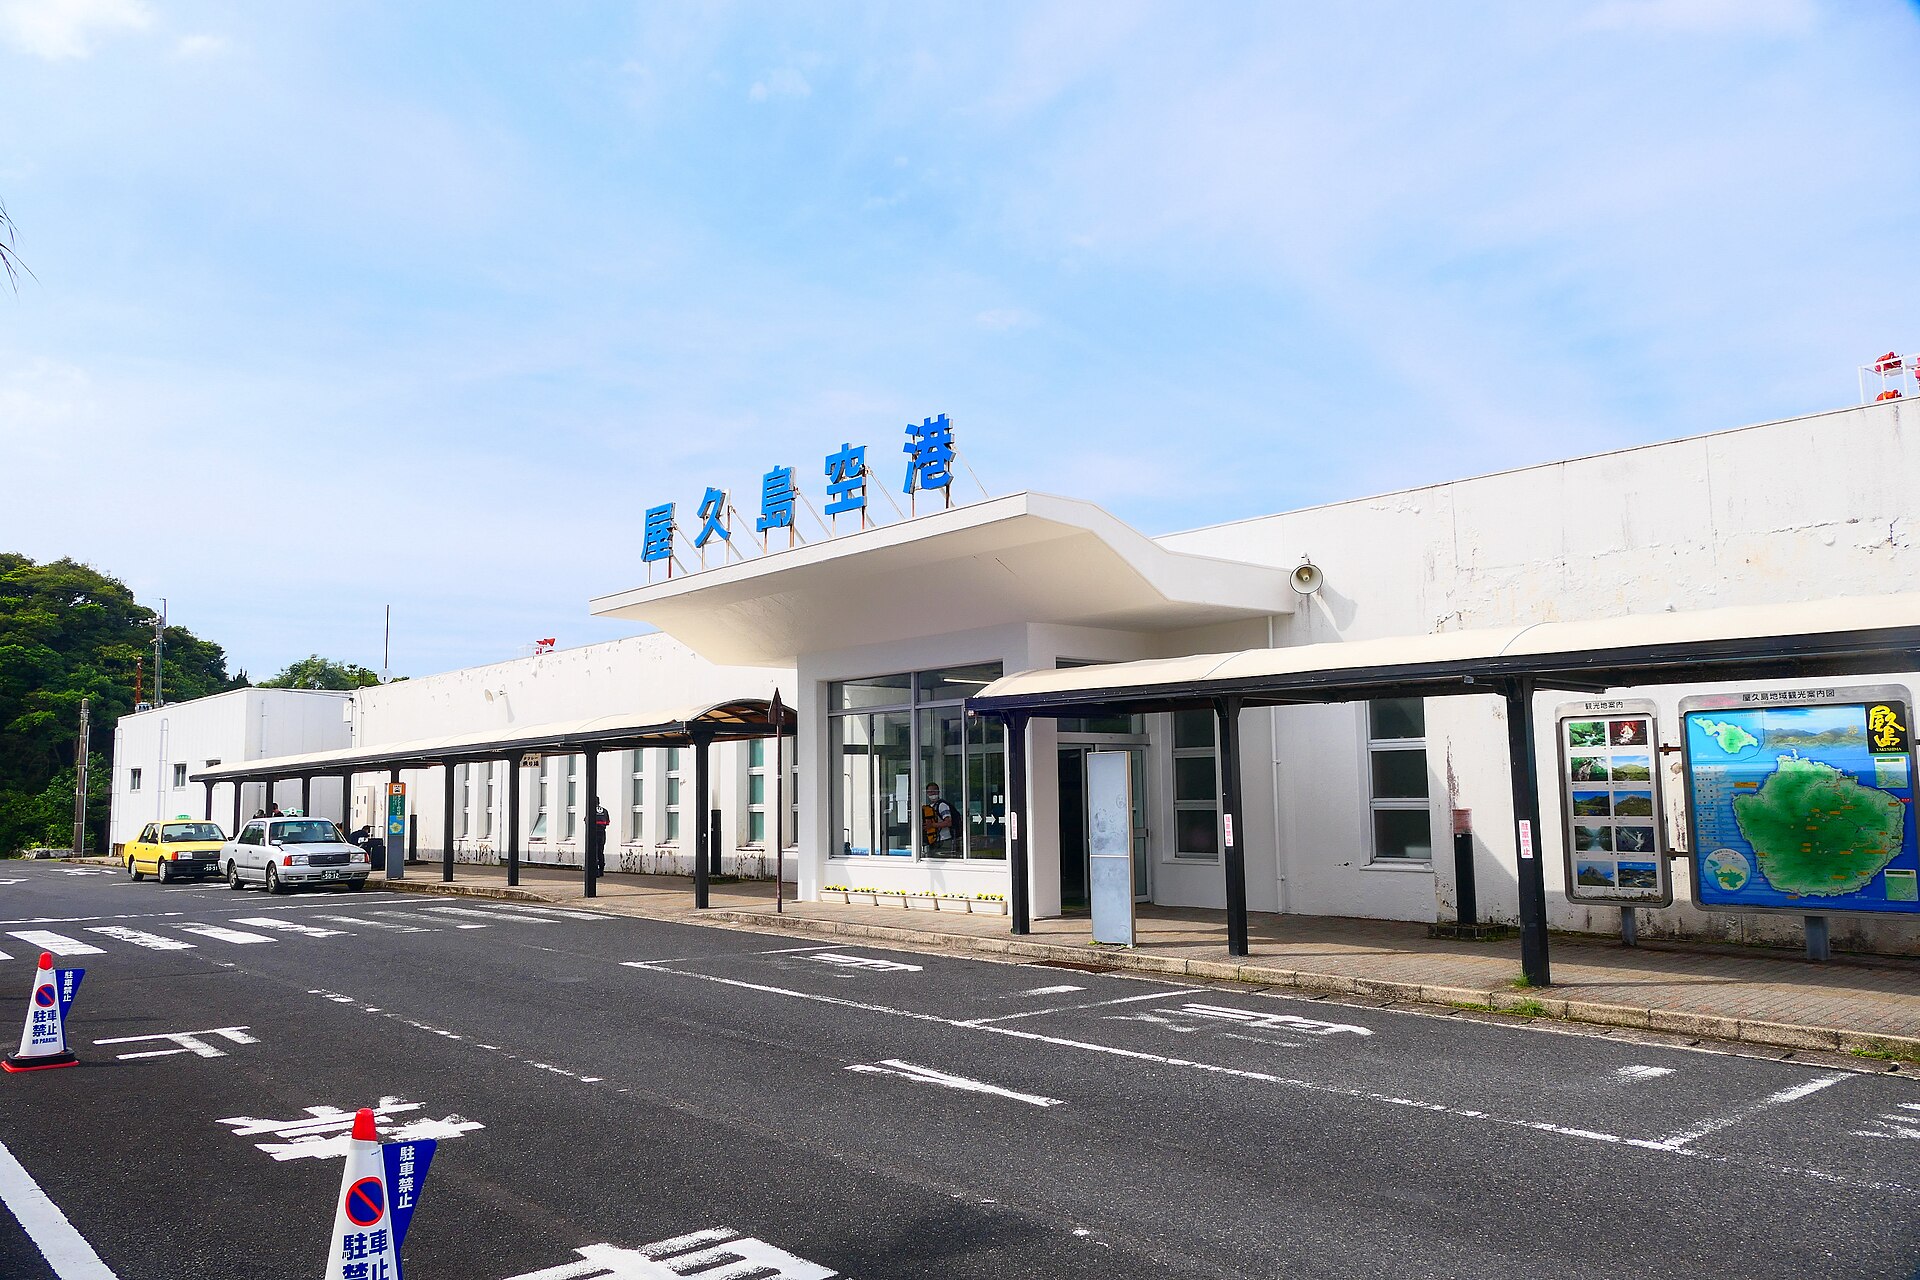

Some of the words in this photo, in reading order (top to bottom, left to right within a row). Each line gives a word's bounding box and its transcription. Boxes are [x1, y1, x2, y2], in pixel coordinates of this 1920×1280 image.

[640, 413, 957, 562] 屋久島空港
[1585, 701, 1624, 710] 観光地案内
[1742, 689, 1835, 702] 屋久島地域観光案内図
[1868, 704, 1906, 748] 屋久島
[1520, 822, 1532, 856] 駐車禁止
[62, 970, 74, 1003] 駐車禁止
[32, 1008, 58, 1024] 駐車
[32, 1023, 58, 1038] 禁止
[397, 1145, 416, 1210] 駐車禁止
[341, 1227, 389, 1261] 駐車
